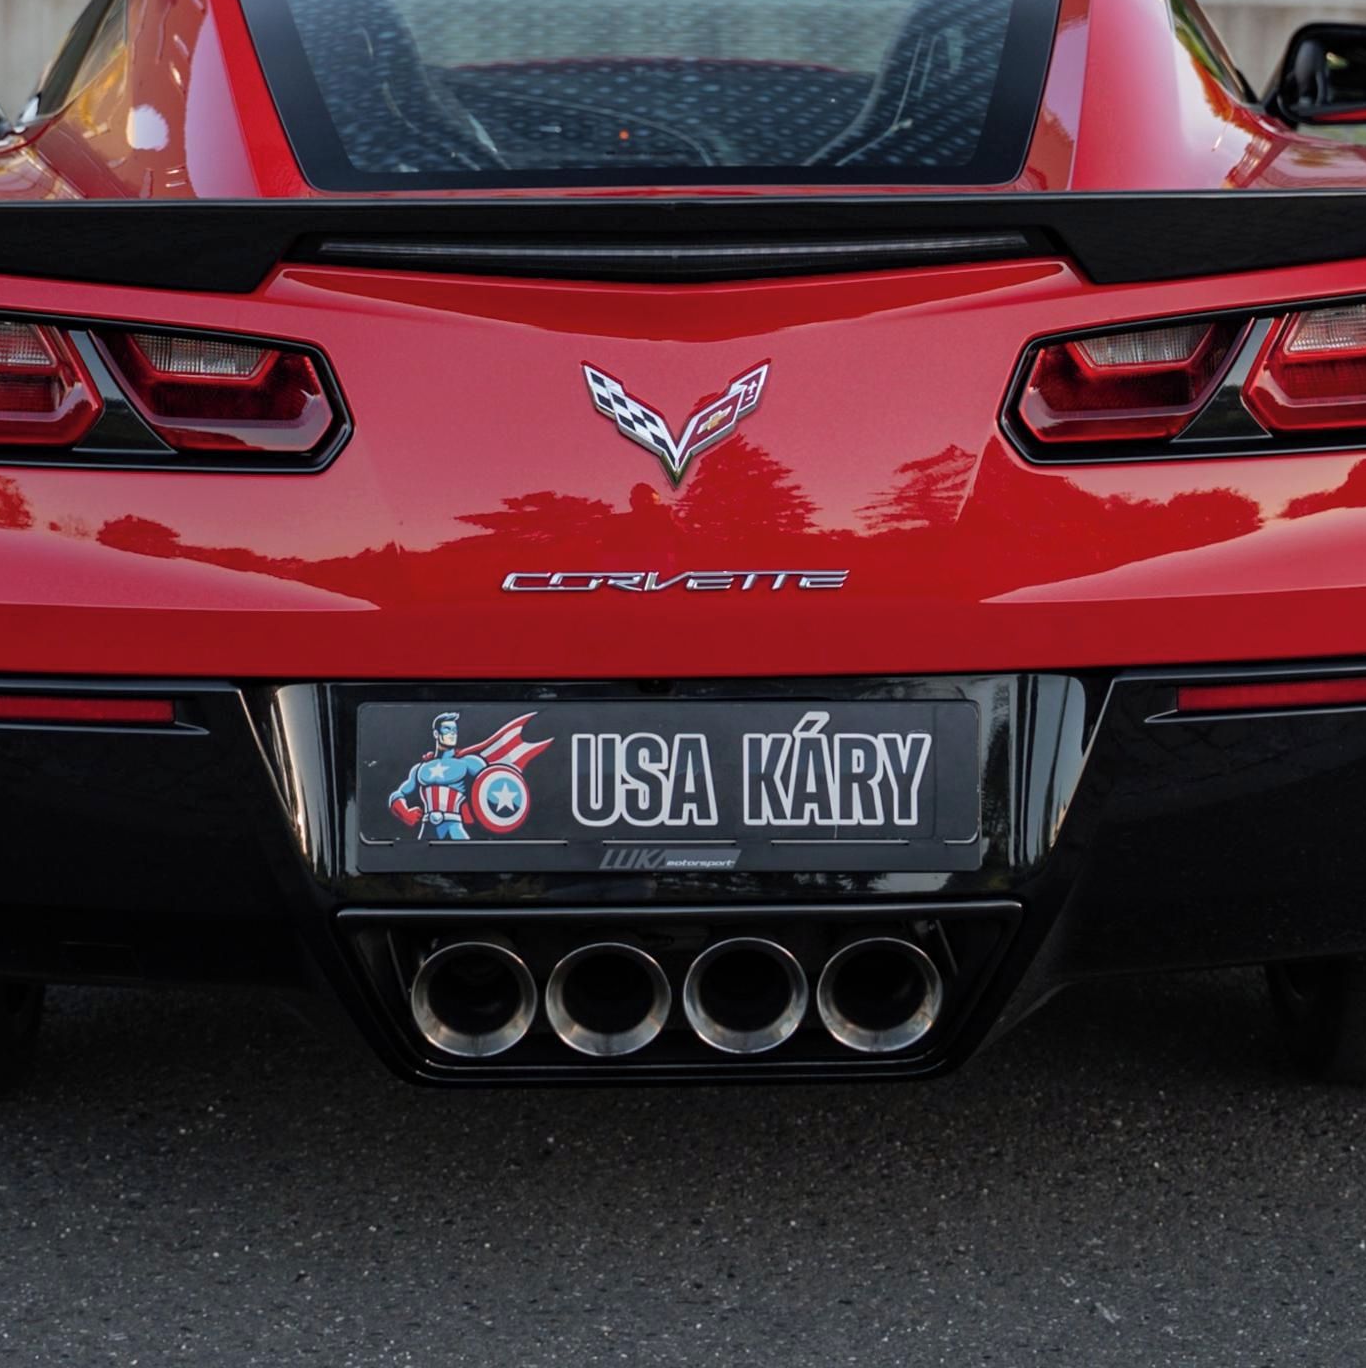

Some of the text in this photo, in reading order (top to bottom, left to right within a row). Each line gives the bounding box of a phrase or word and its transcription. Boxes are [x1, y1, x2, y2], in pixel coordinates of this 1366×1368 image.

[501, 570, 850, 591] CORVETTE
[571, 711, 932, 827] USA KÁRY
